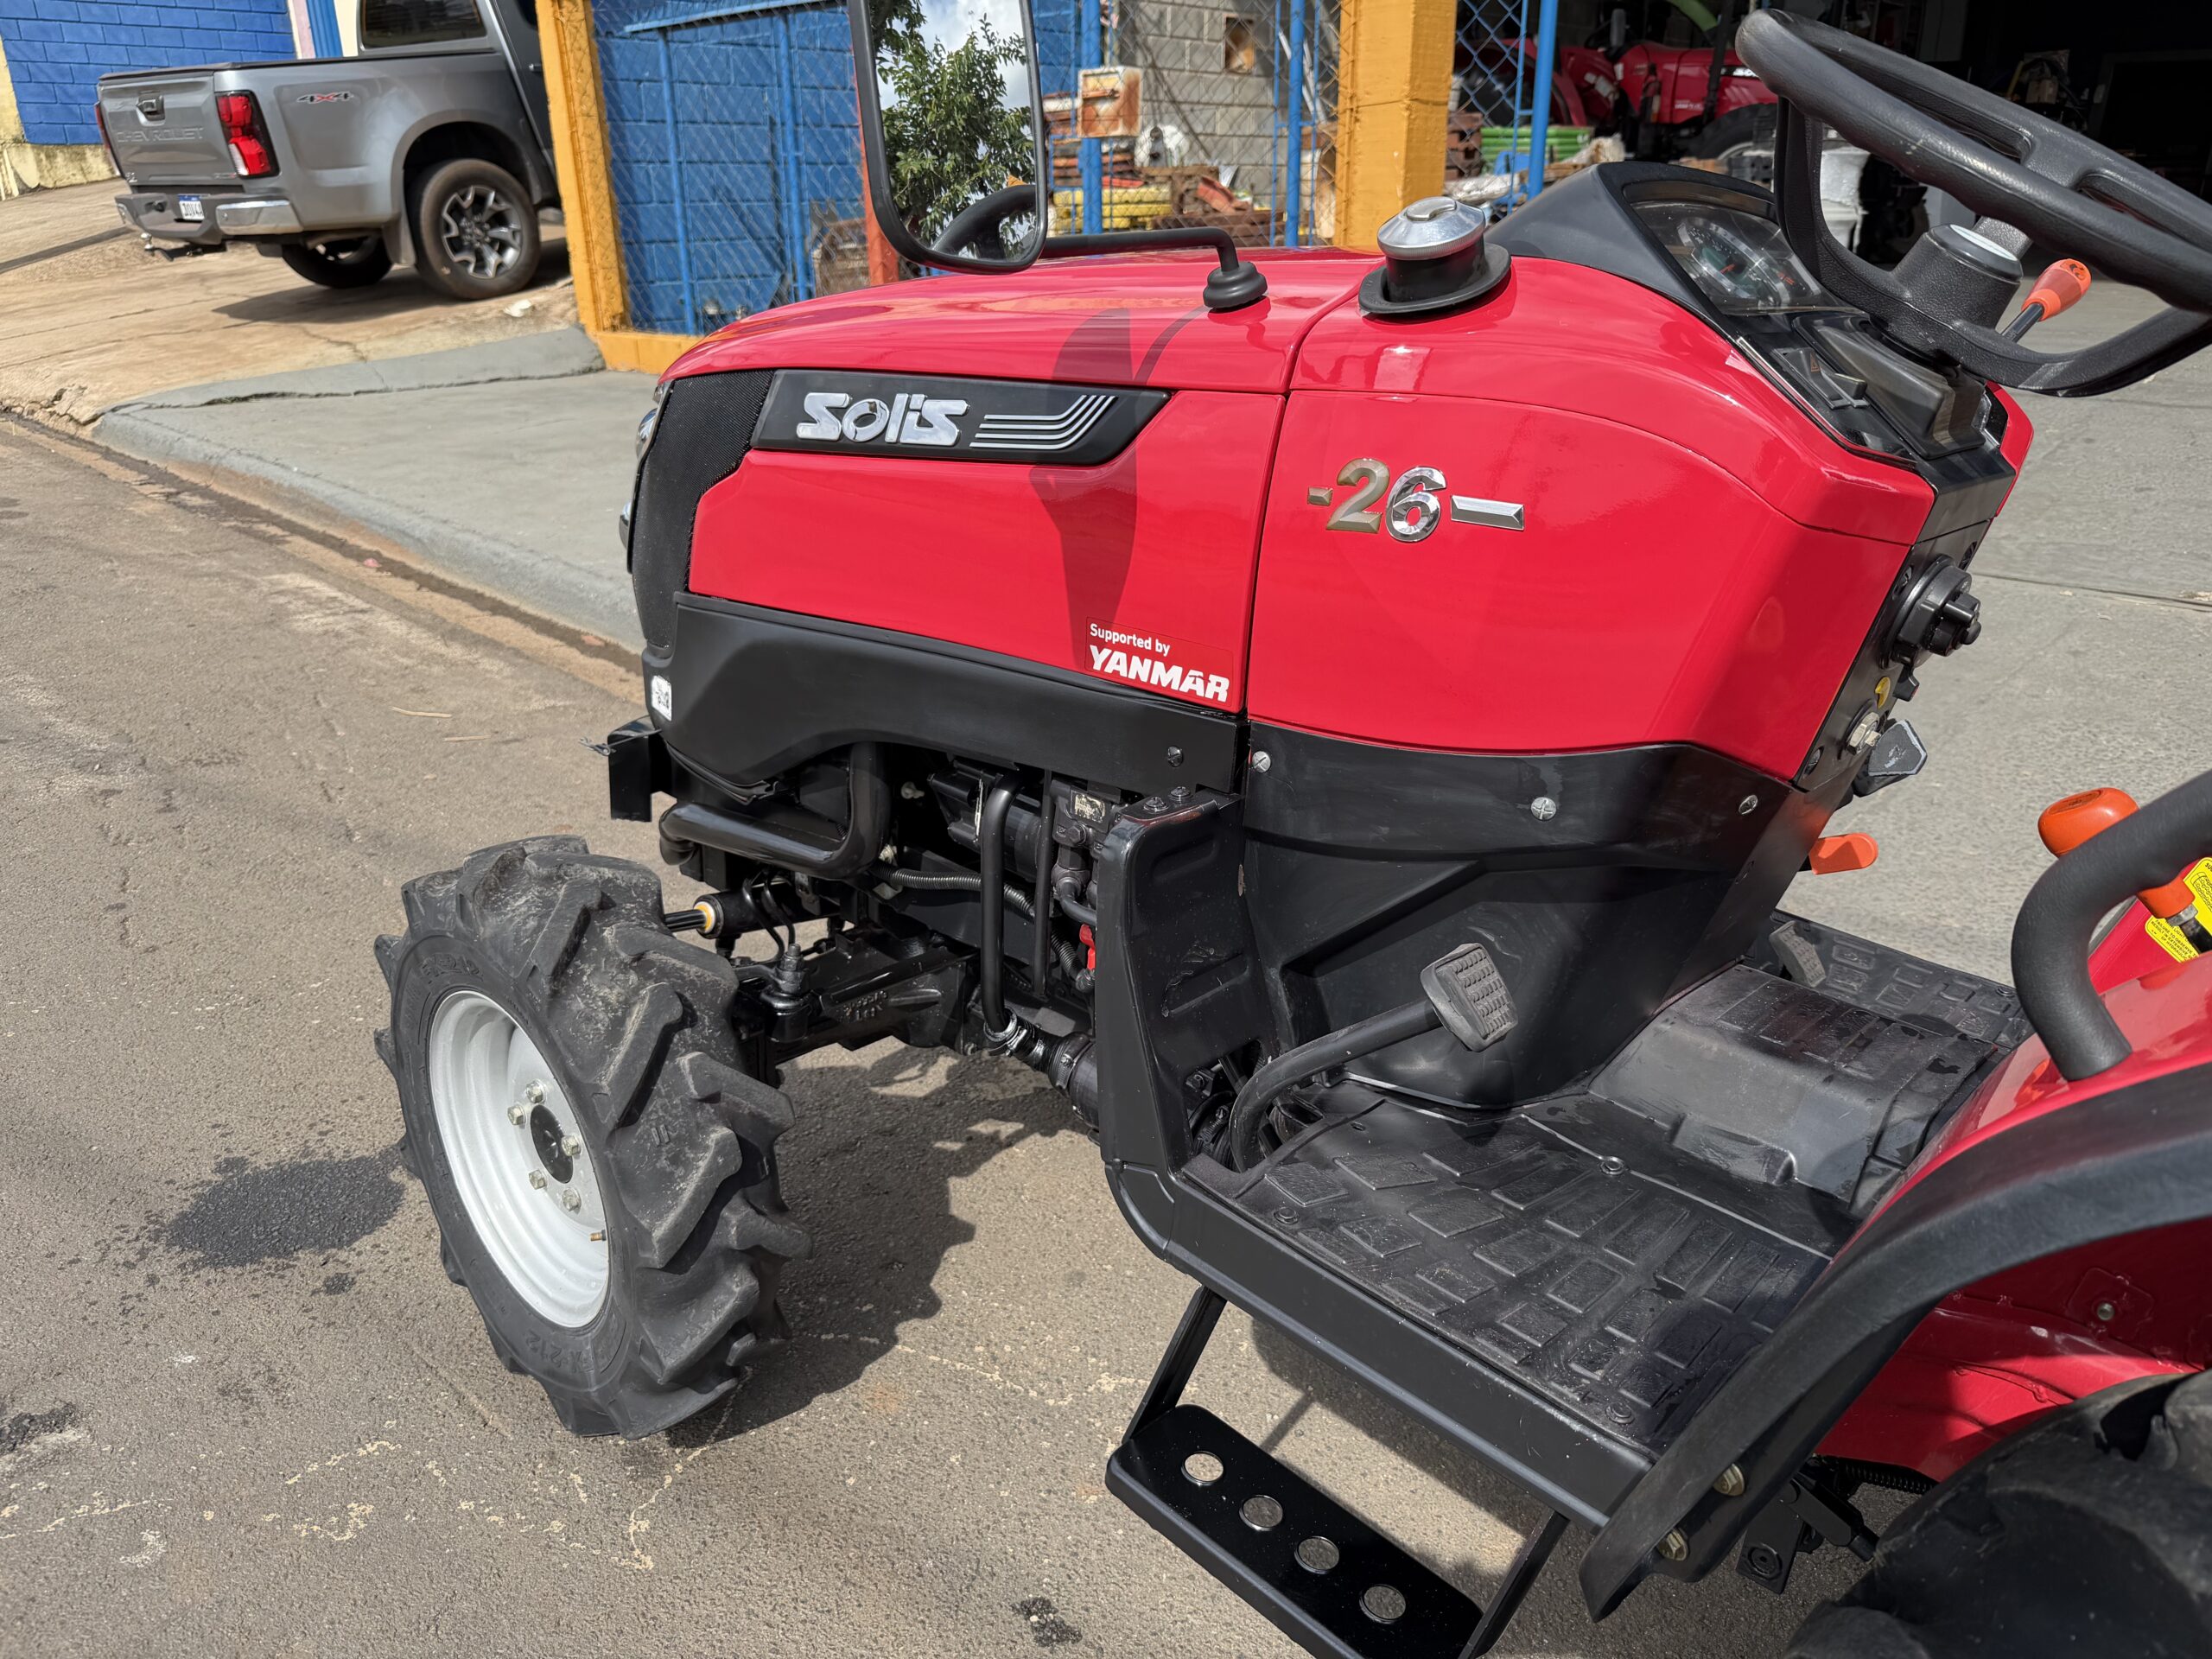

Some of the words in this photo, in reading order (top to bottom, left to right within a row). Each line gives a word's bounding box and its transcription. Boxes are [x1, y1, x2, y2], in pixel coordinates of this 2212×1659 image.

[117, 127, 204, 143] CHEVROLET
[1090, 623, 1152, 651] Supported
[1155, 639, 1171, 657] by
[1090, 645, 1230, 702] YANMAR
